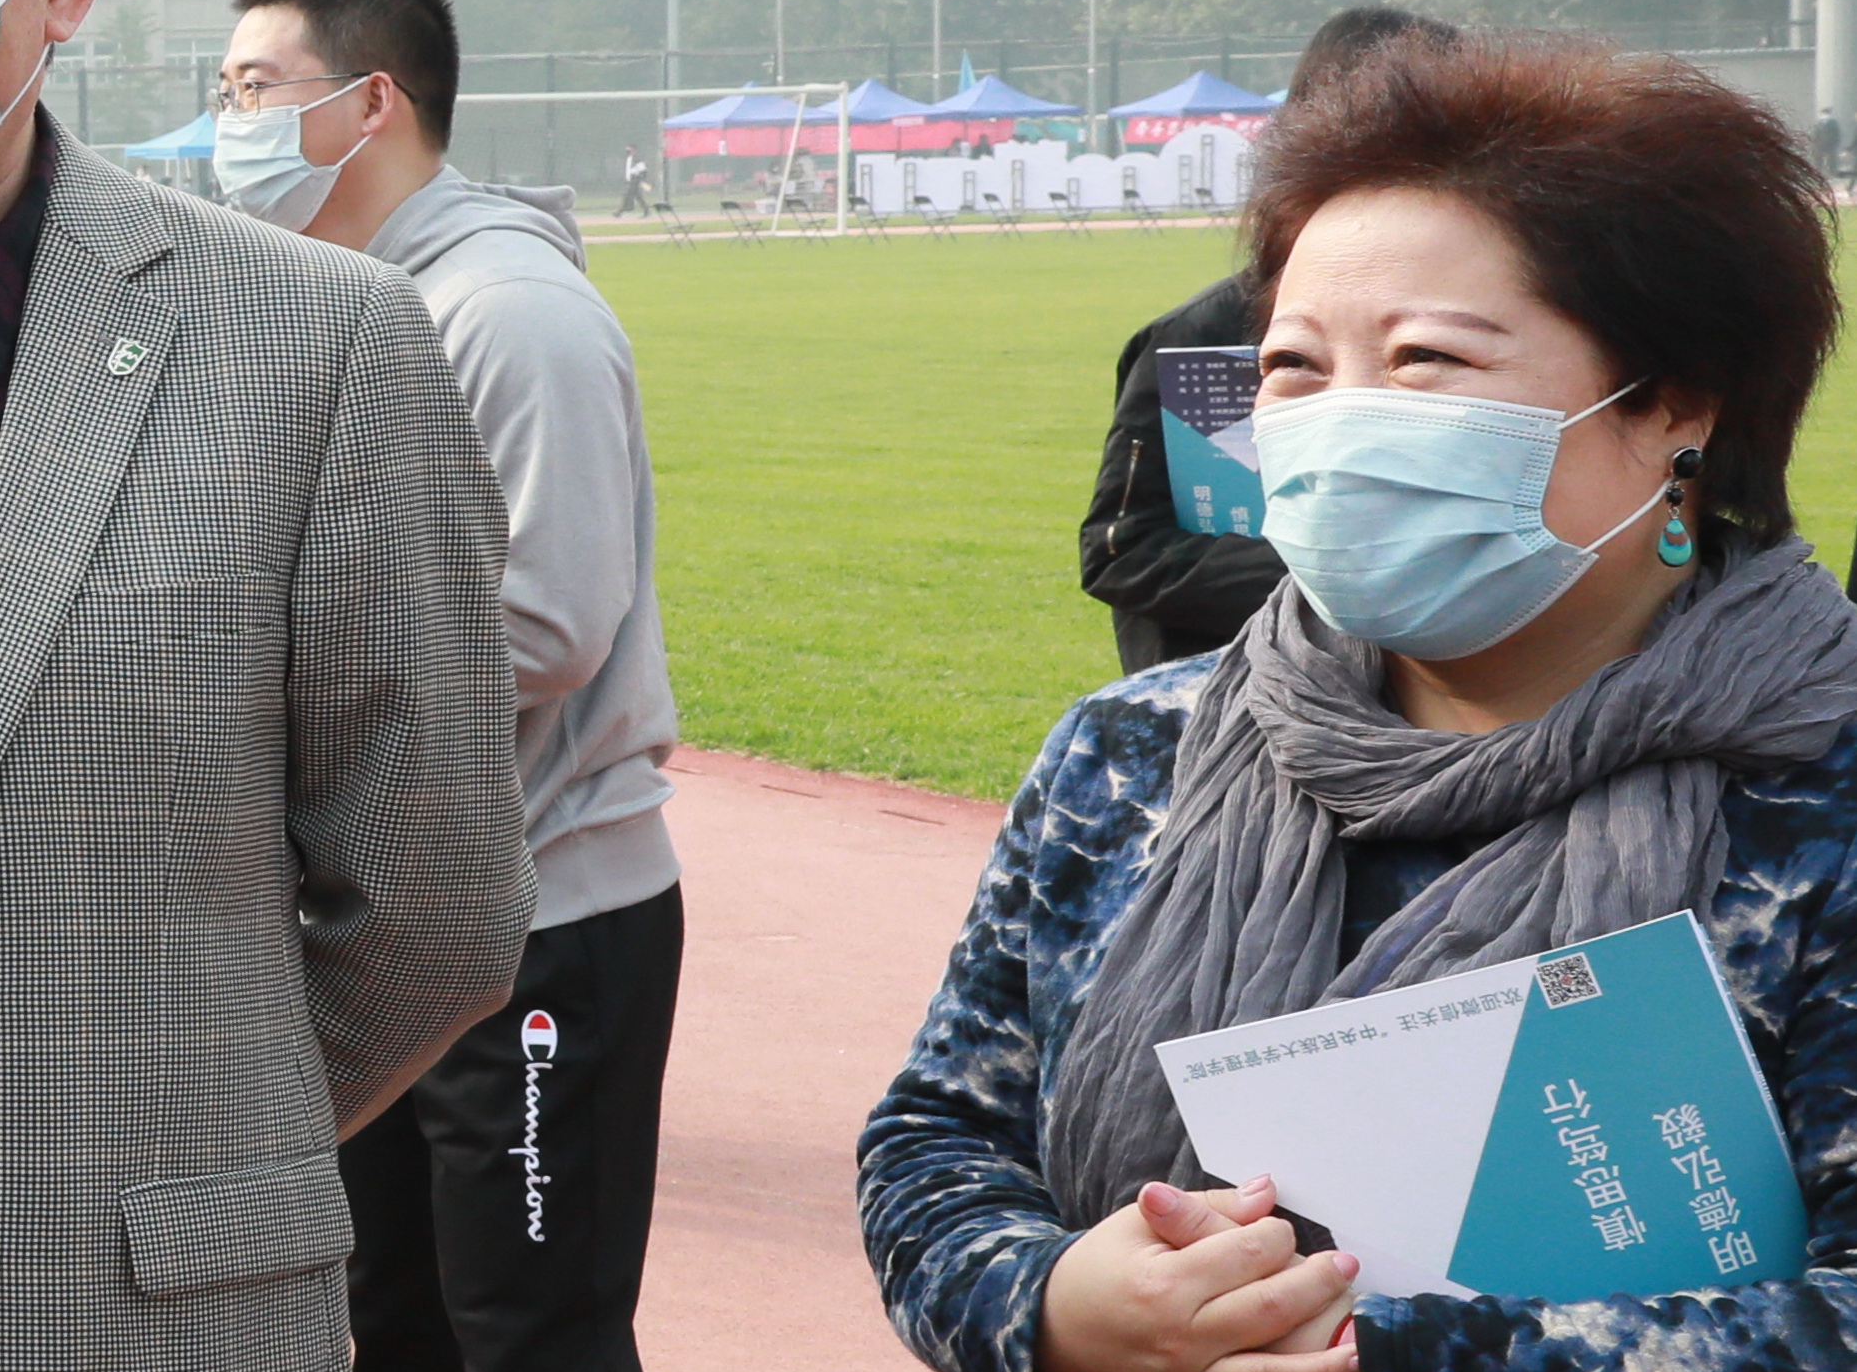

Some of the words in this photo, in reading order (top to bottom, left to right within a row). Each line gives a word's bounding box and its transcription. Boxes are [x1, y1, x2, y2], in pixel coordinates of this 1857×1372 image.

[508, 1009, 559, 1243] Champion
[1543, 1078, 1647, 1251] 慎思笃行
[1651, 1103, 1758, 1275] 明德弘毅
